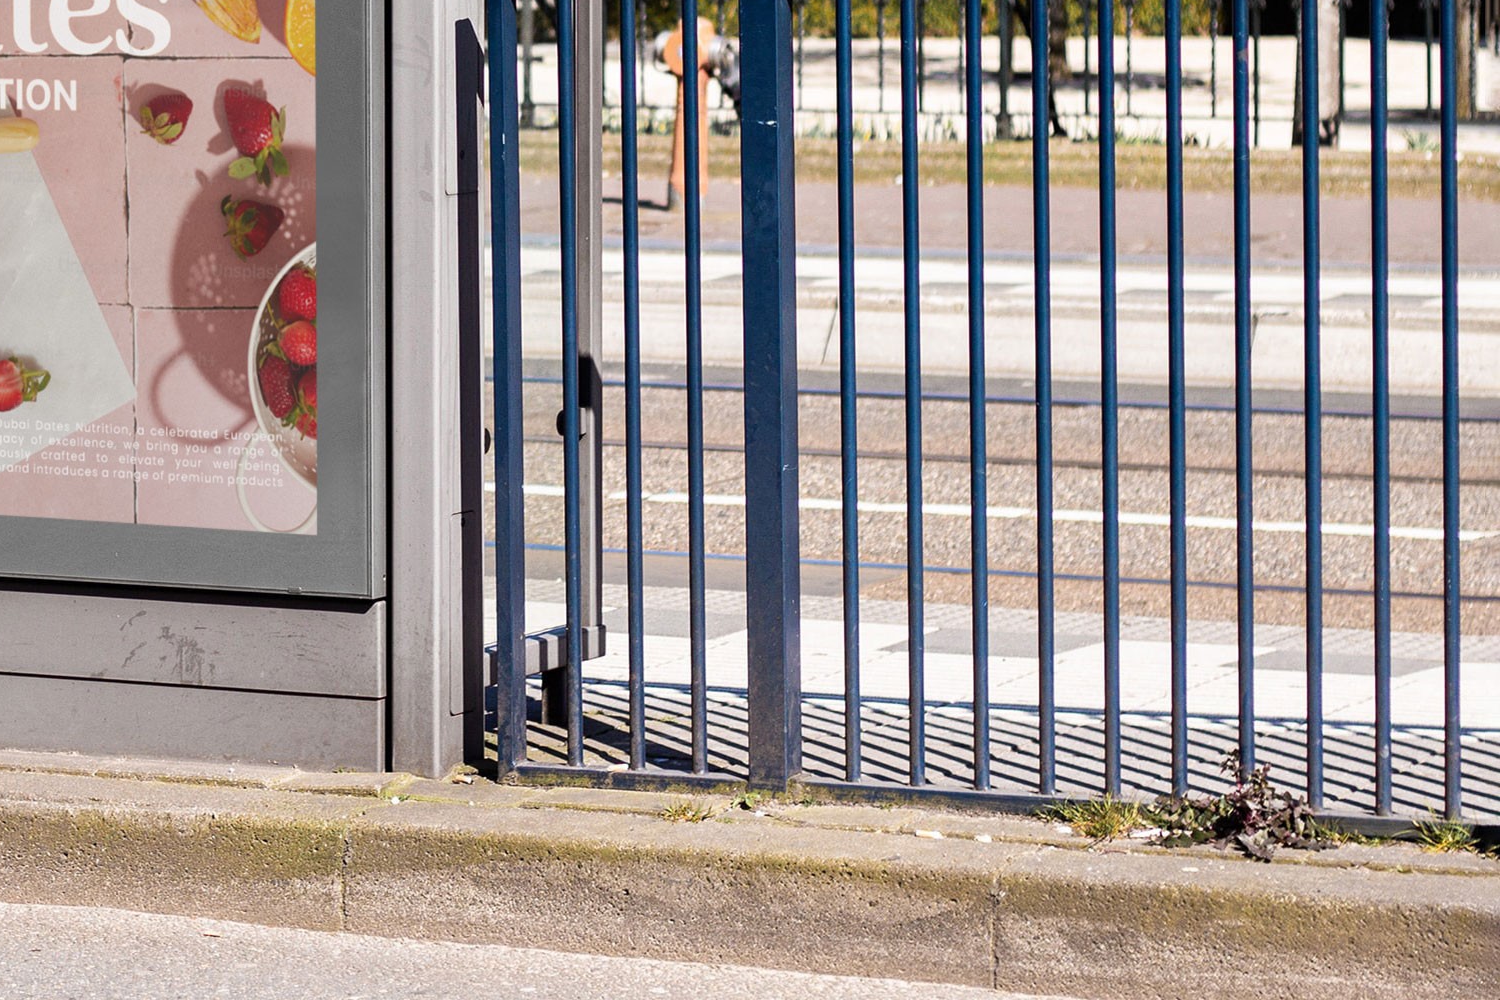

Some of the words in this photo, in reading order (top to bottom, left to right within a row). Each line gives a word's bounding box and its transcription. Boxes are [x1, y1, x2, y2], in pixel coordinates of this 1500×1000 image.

[36, 421, 70, 432] Dates
[76, 423, 131, 436] Nutrition,
[150, 427, 218, 439] celebrated
[31, 435, 42, 445] of
[147, 441, 178, 454] bring
[185, 445, 207, 456] you
[213, 446, 221, 454] a
[228, 447, 264, 458] range
[271, 448, 283, 457] of
[41, 451, 86, 462] crafted
[96, 454, 108, 463] to
[119, 455, 164, 465] elevate
[175, 459, 202, 469] your
[33, 463, 98, 477] introduces
[113, 469, 149, 482] range
[152, 471, 165, 480] of
[168, 471, 224, 484] premium
[227, 474, 284, 487] products
